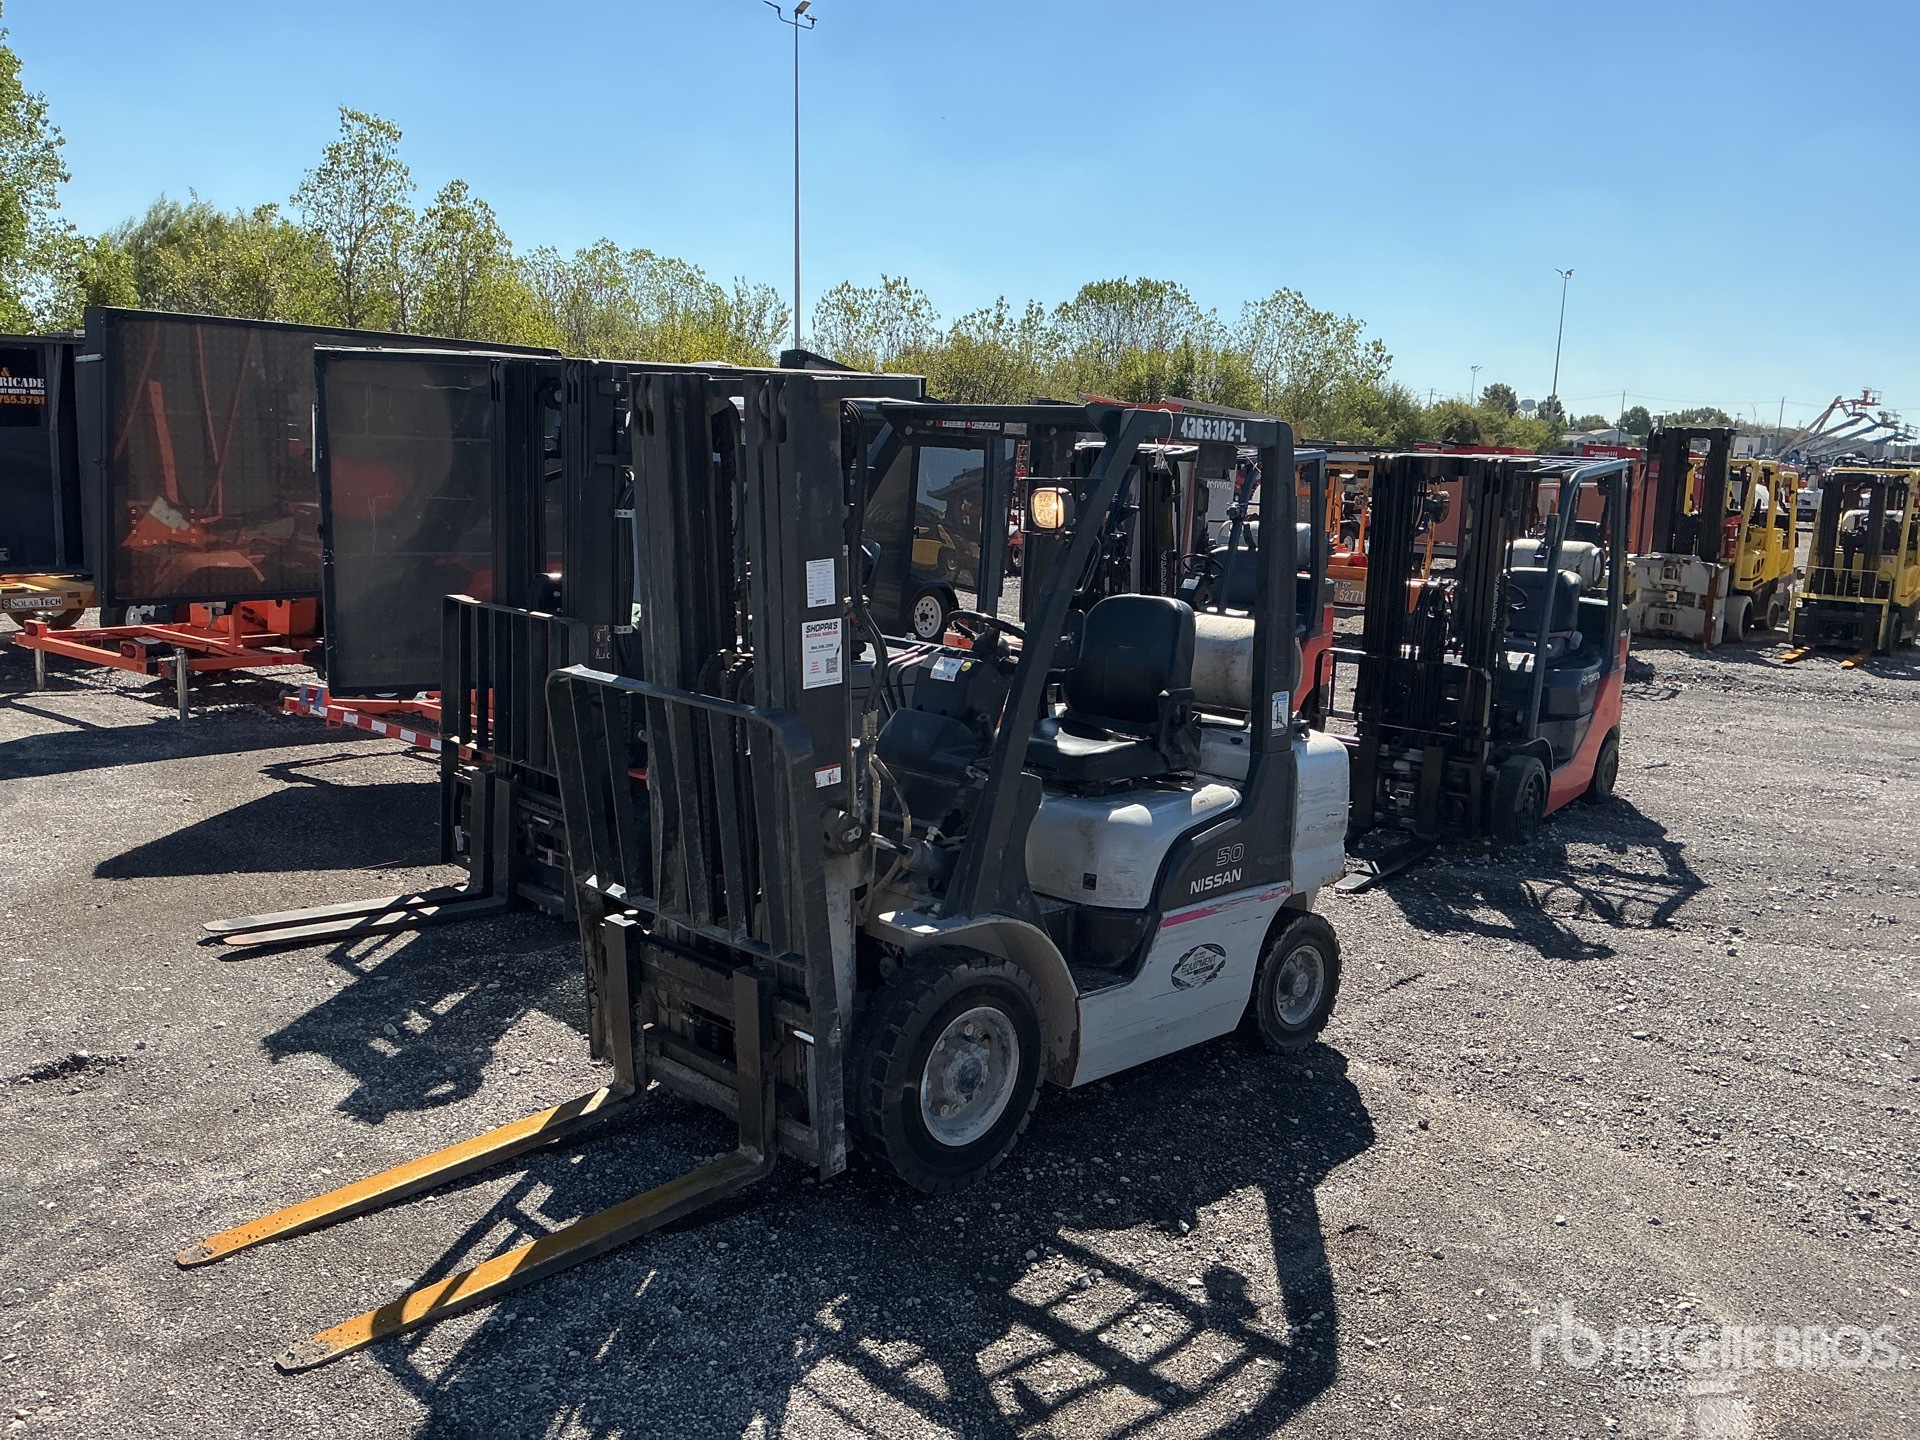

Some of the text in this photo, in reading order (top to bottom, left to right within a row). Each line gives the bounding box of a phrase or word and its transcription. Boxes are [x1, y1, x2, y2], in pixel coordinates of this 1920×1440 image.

[0, 377, 45, 388] RICADE
[1181, 416, 1247, 443] 4363302-L
[1339, 590, 1364, 602] 52771
[1490, 572, 1501, 632] TOYOTA
[805, 621, 839, 634] SHOPPA'S
[1216, 843, 1244, 867] 50
[1189, 868, 1242, 895] NISSAN
